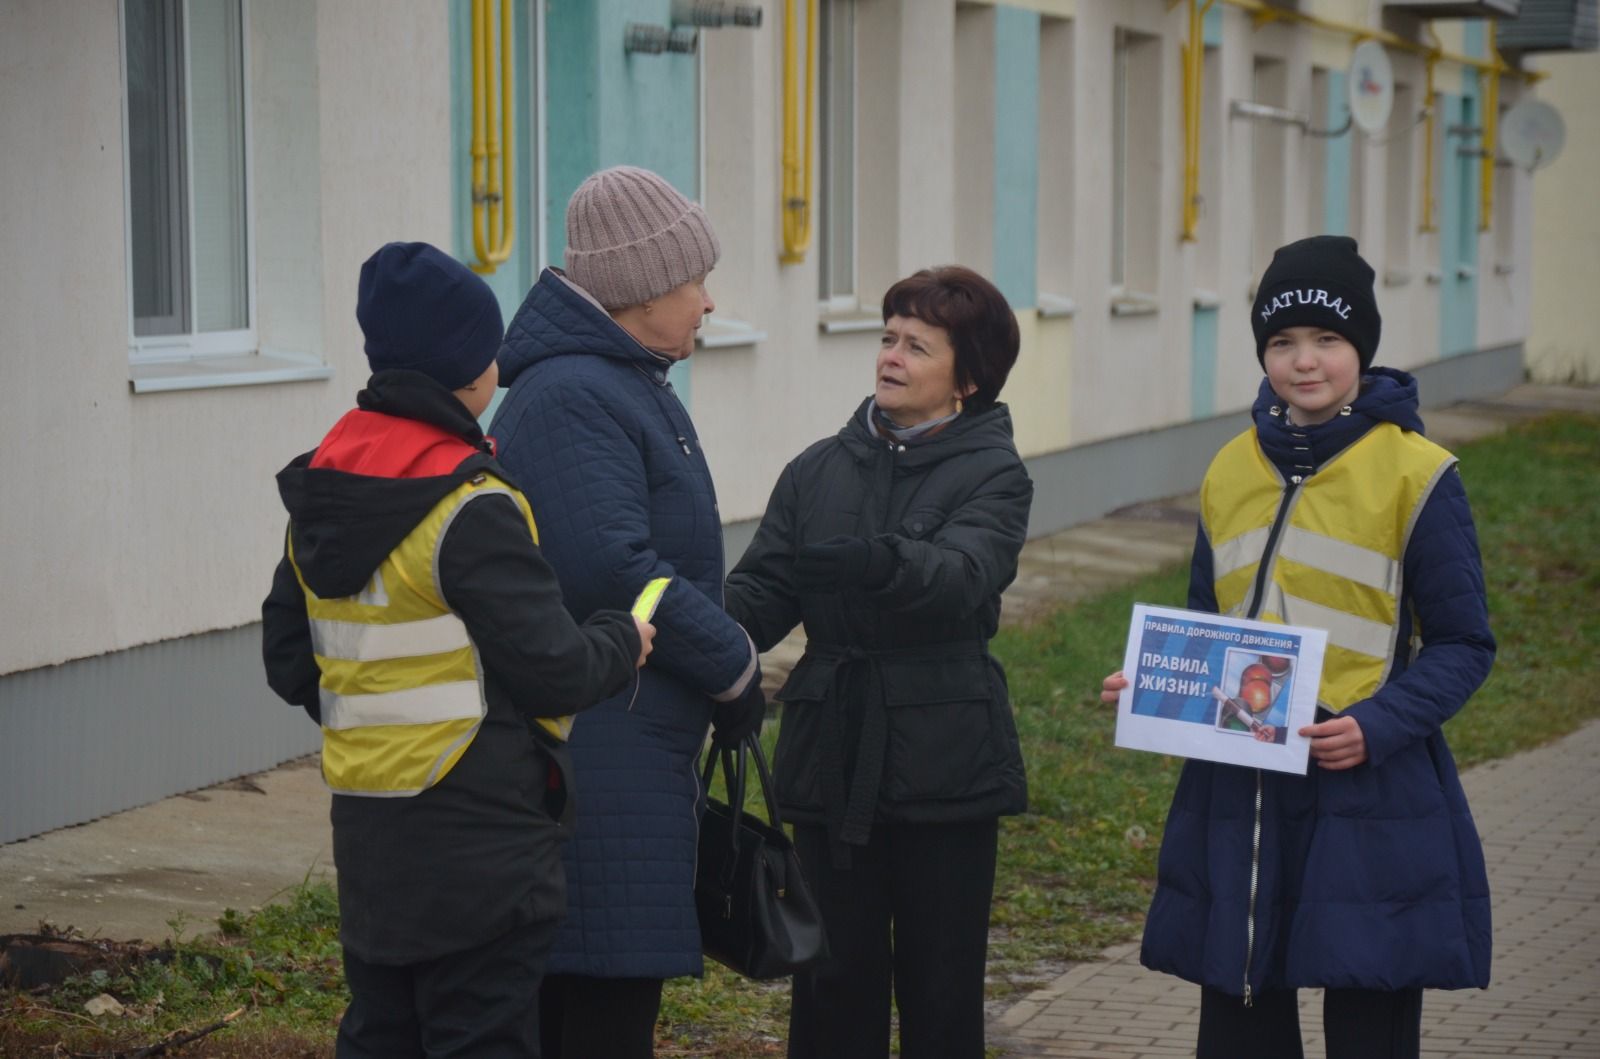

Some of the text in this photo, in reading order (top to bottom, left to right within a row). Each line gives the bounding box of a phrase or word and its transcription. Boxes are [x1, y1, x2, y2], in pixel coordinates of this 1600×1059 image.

[1261, 289, 1352, 323] NATURAL
[1145, 621, 1185, 634] ПРАВИЛА
[1186, 626, 1240, 642] ДОРОЖНОГО
[1241, 634, 1293, 649] ДВИЖЕНИЯ
[1142, 652, 1209, 675] ПРАВИЛА
[1139, 673, 1207, 698] ЖИЗНИ!
